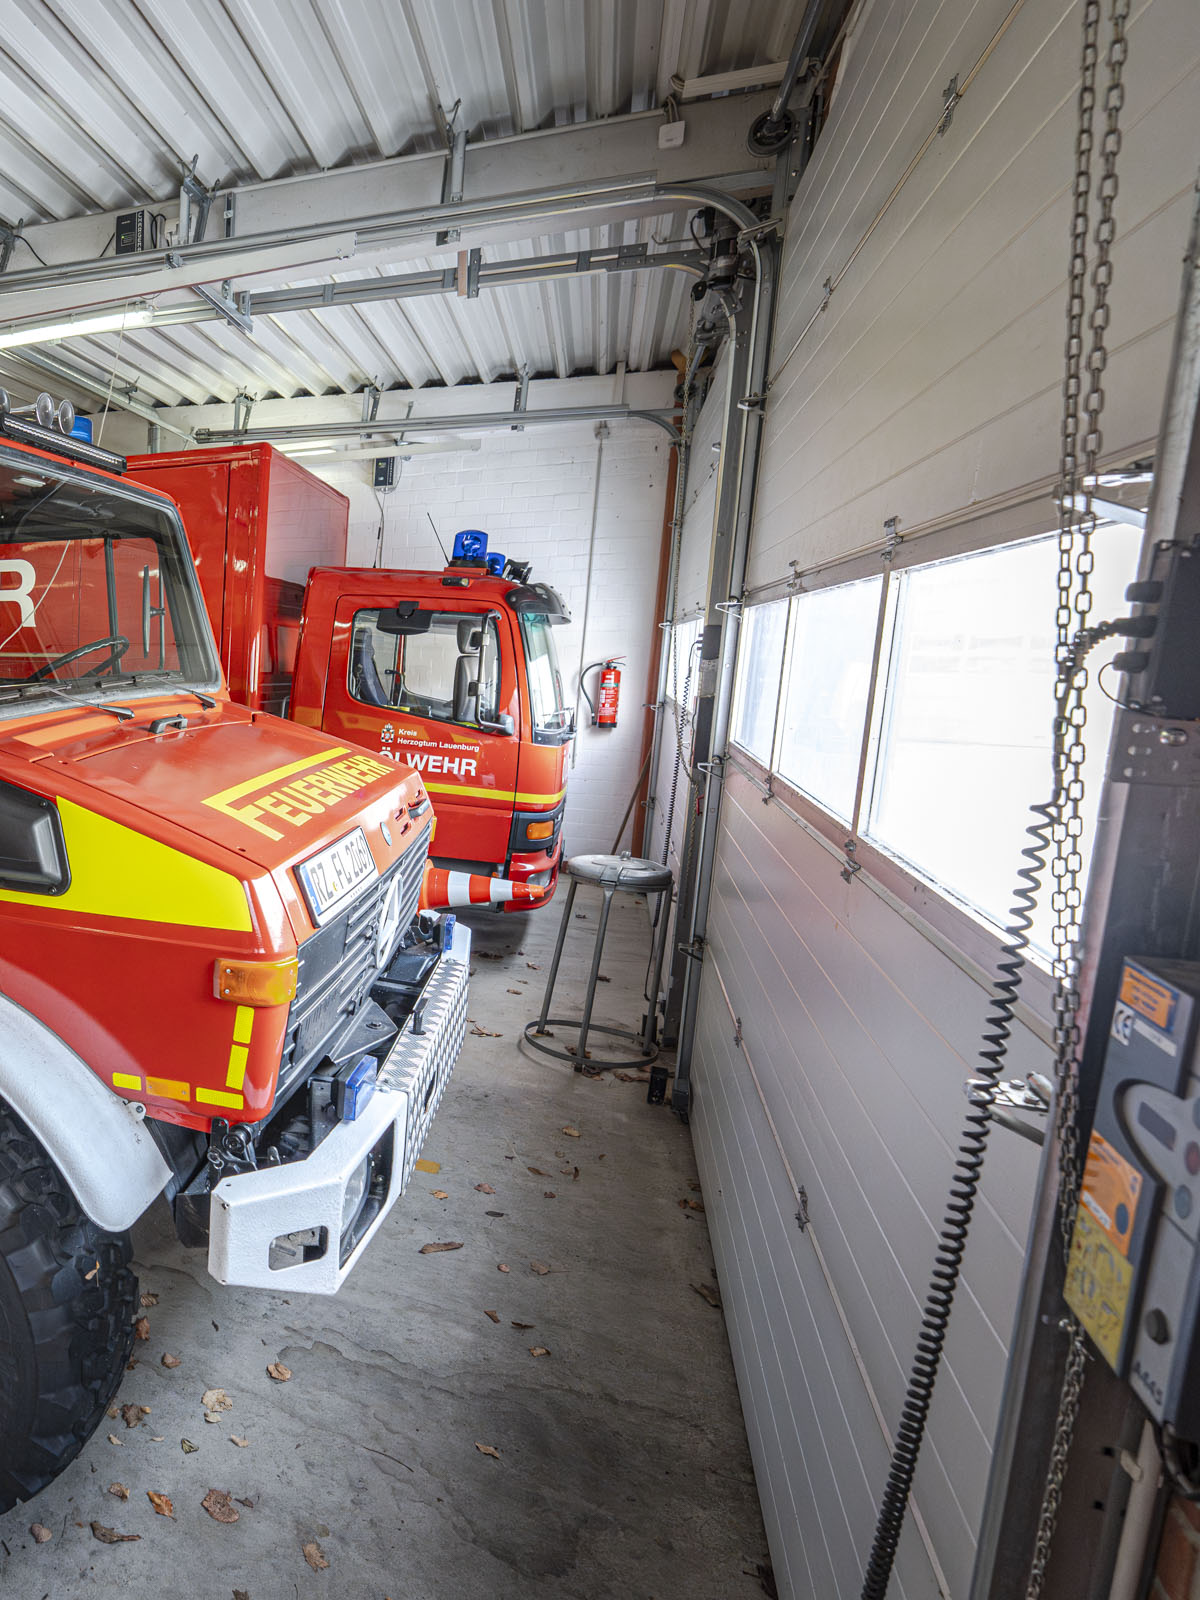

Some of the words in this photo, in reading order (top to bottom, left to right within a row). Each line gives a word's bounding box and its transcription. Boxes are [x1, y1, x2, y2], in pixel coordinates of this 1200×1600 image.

[396, 737, 438, 749] Herzogtum
[438, 741, 480, 753] Lauenburg
[398, 728, 418, 737] Kreis
[202, 746, 396, 842] FEUERWEHR
[310, 861, 335, 906] RZ
